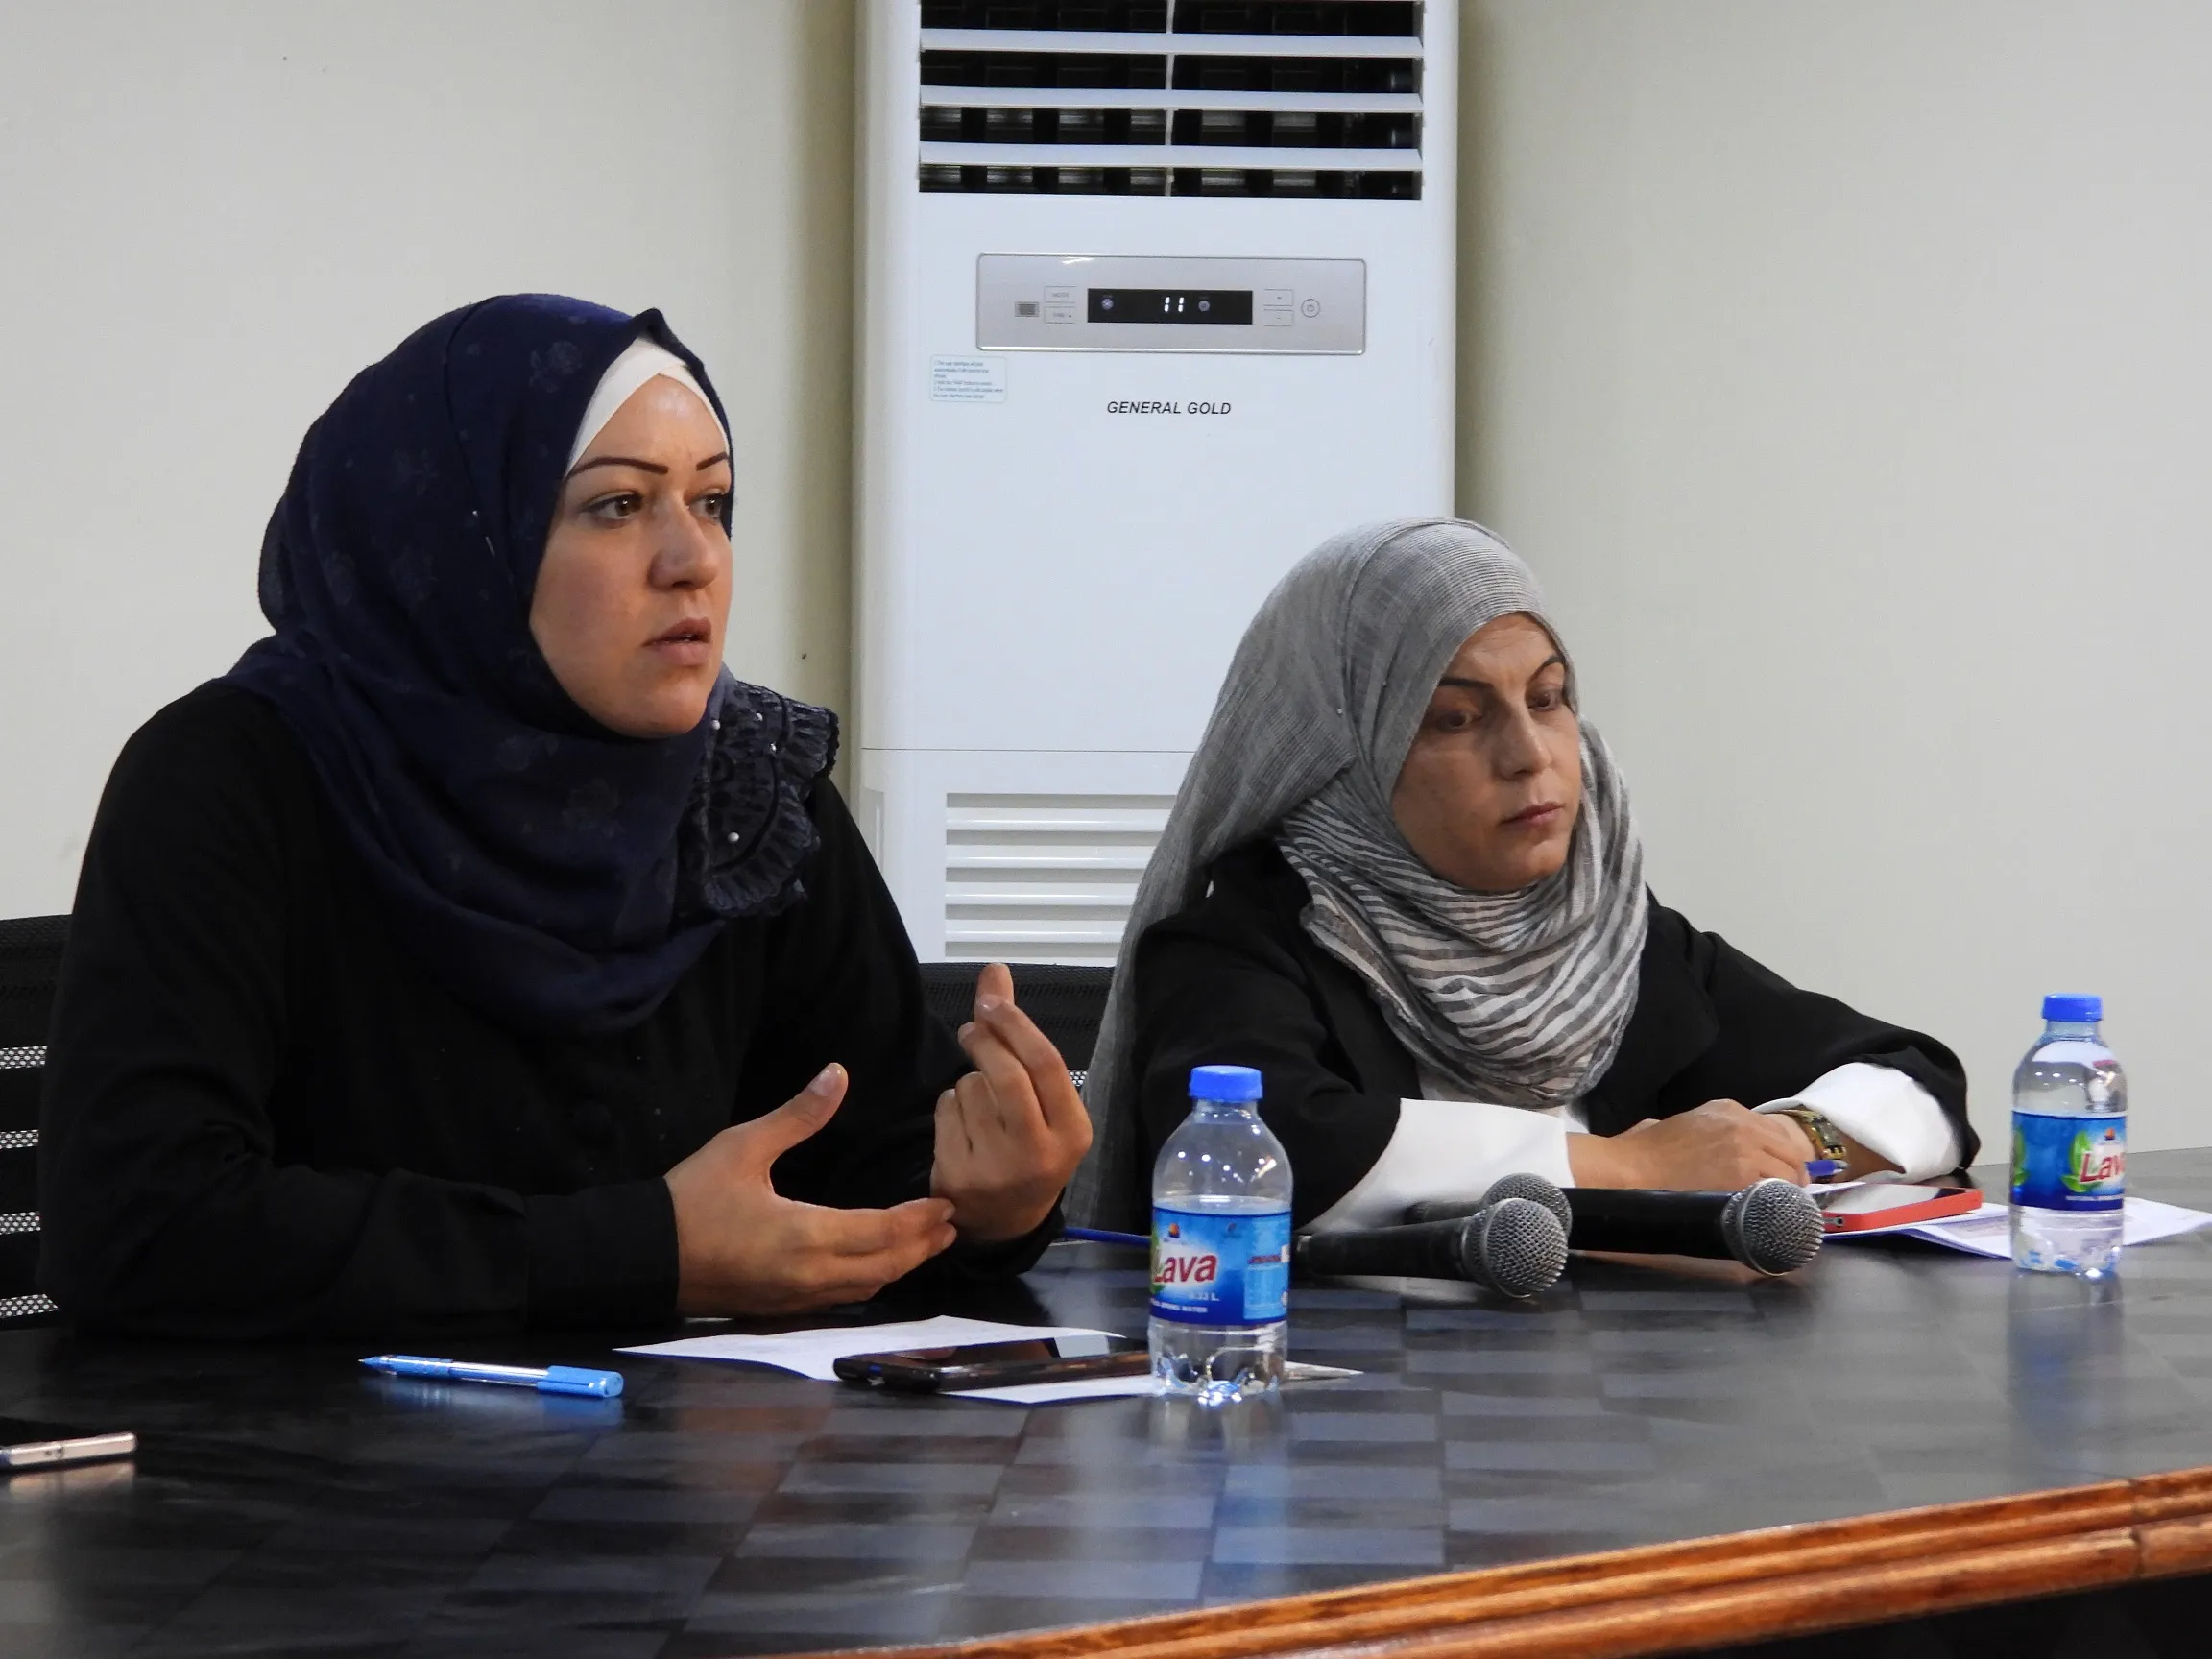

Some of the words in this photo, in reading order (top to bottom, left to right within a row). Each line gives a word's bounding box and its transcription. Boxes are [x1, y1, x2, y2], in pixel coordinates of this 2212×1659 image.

[1164, 296, 1185, 313] 11
[1107, 401, 1182, 414] GENERAL
[1187, 401, 1232, 415] GOLD
